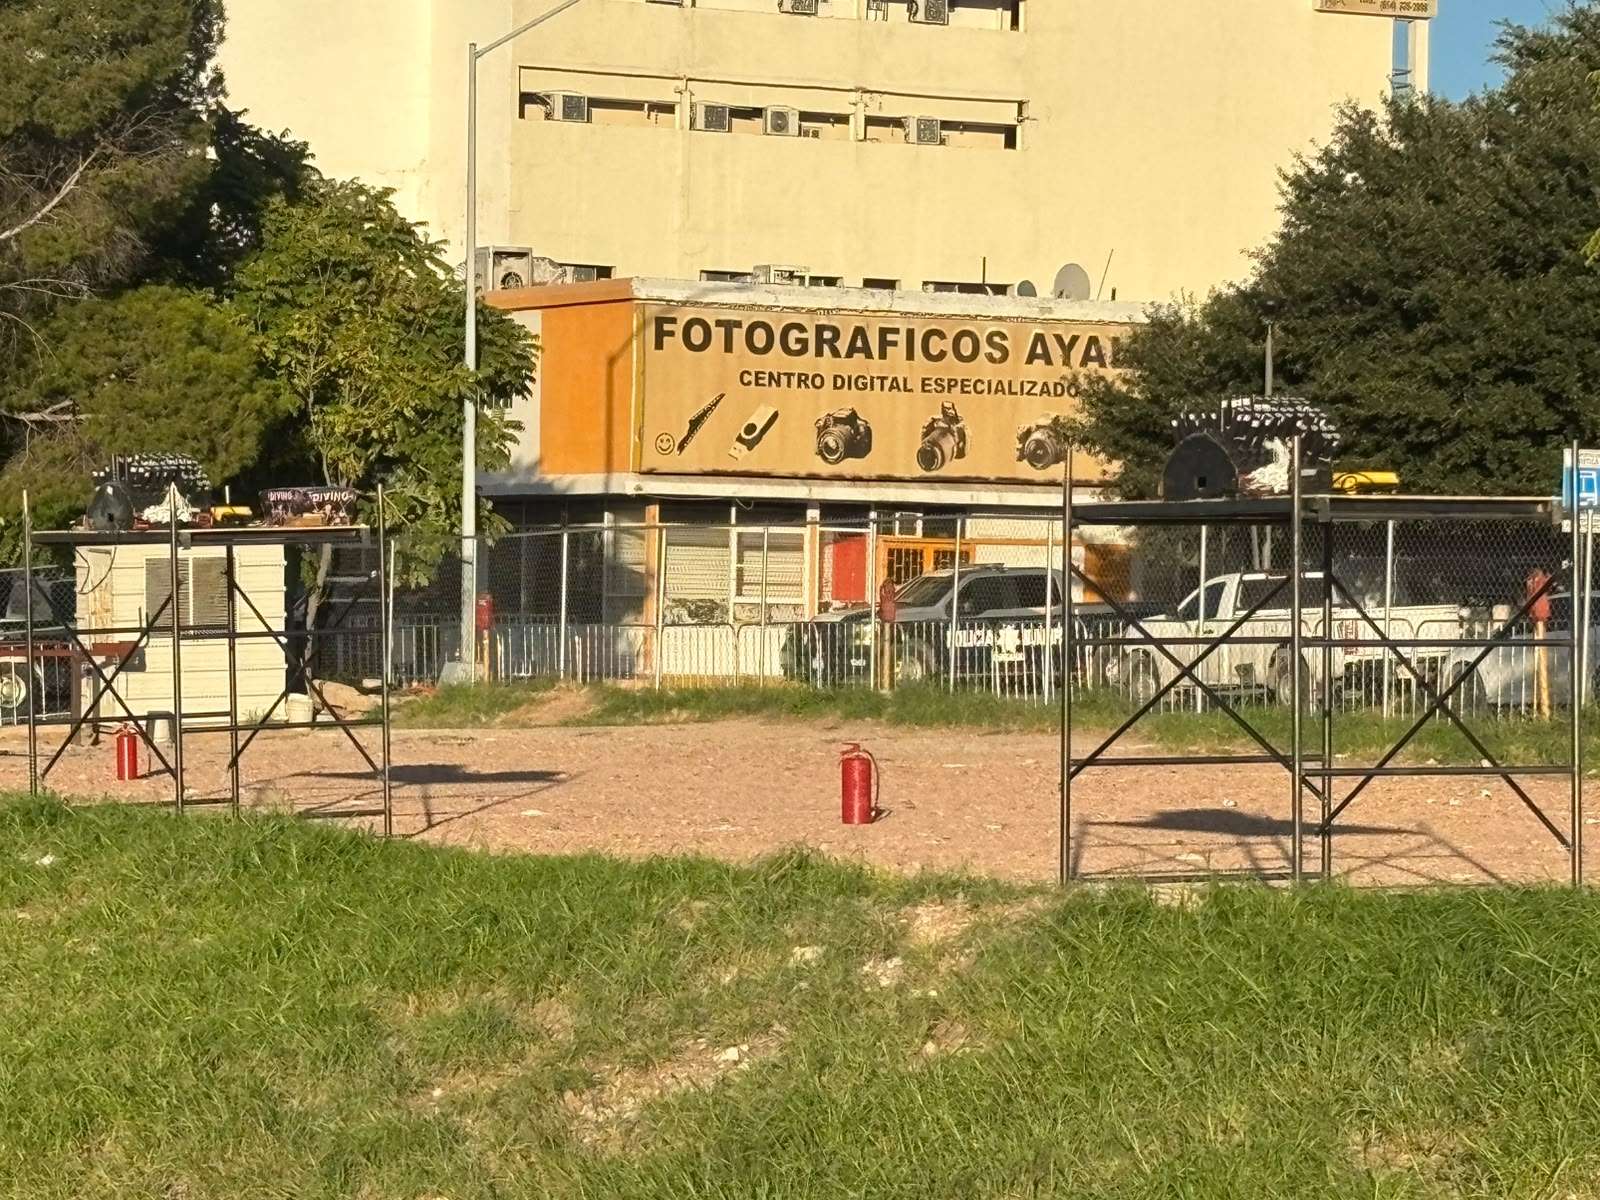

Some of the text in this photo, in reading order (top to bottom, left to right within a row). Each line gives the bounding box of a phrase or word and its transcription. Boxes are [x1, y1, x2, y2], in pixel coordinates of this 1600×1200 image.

[653, 315, 1010, 365] FOTOGRAFICOS
[739, 369, 1080, 397] CENTRO DIGITAL ESPECIALIZADO
